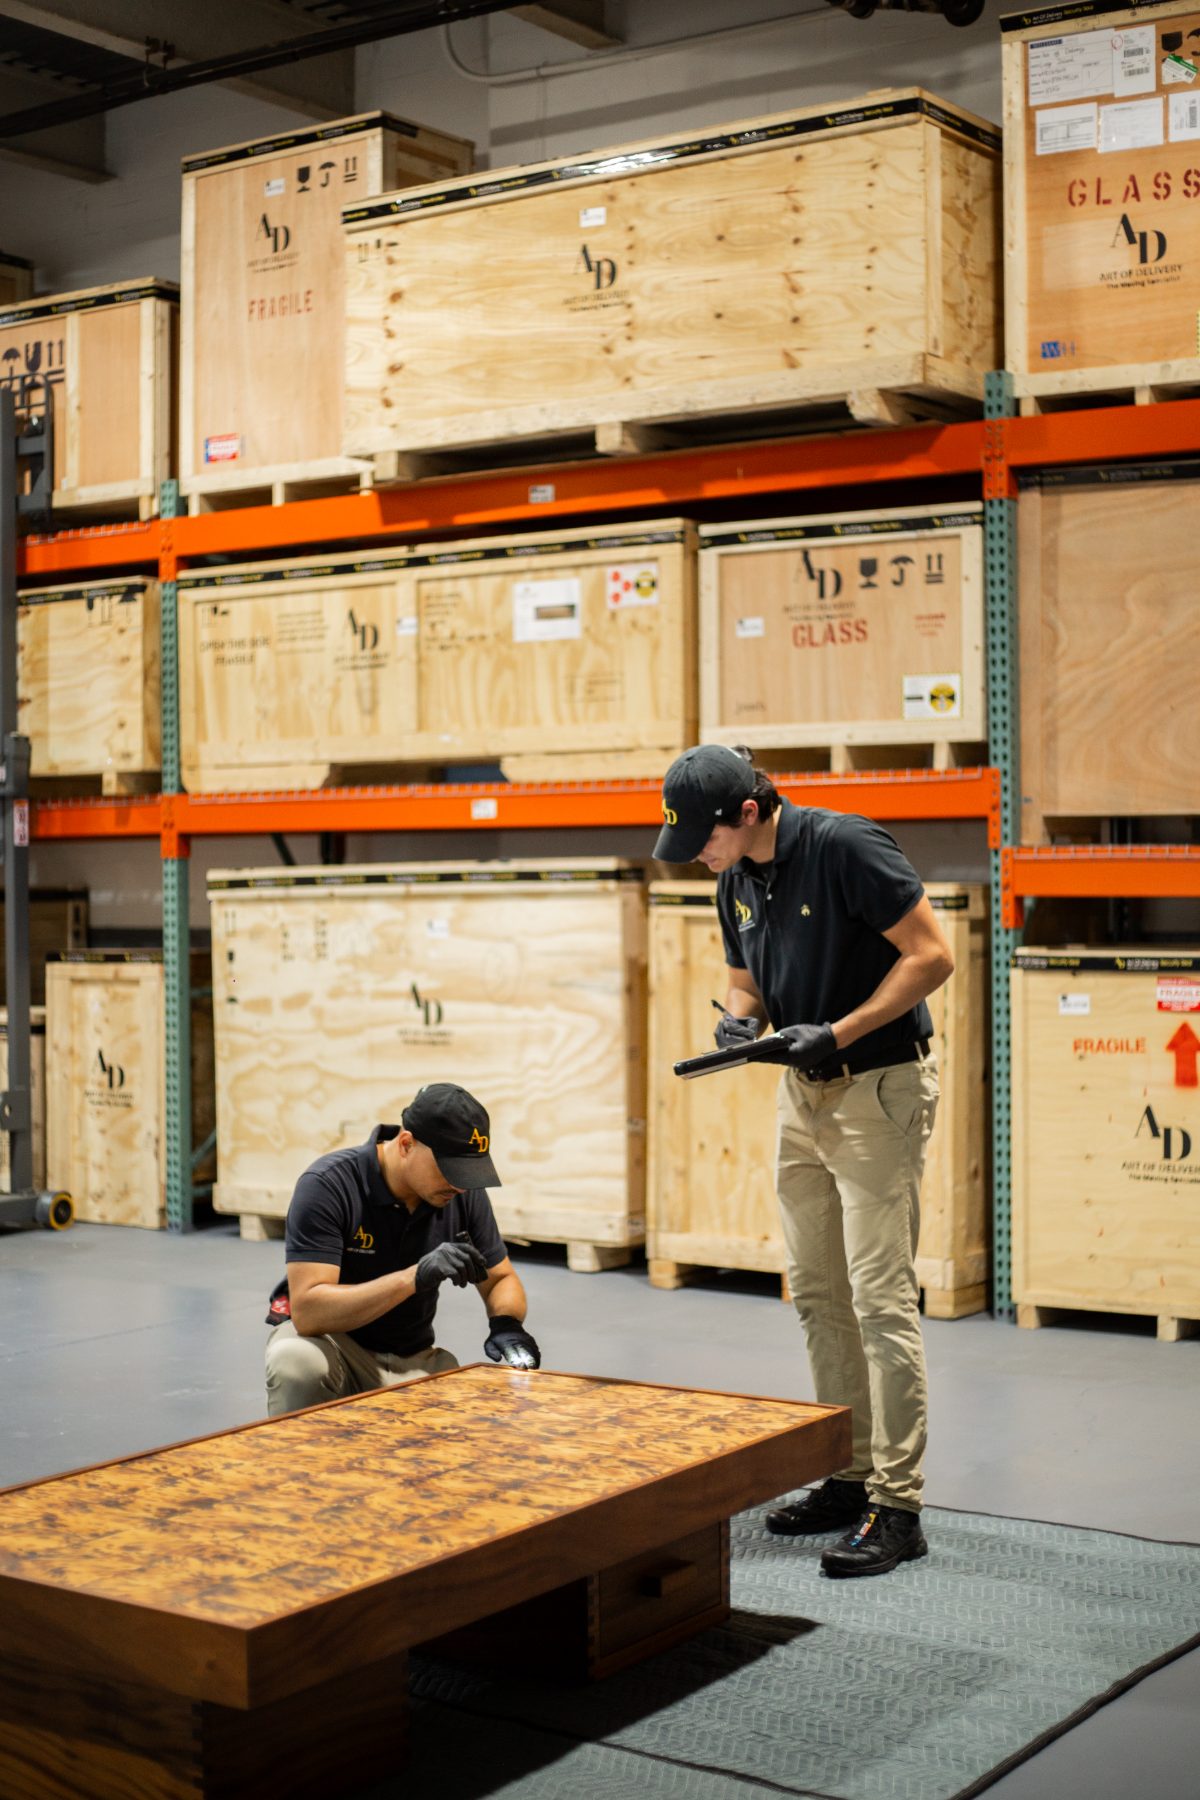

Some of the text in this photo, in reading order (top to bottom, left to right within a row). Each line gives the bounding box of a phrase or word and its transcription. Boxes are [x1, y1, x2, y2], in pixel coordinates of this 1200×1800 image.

[1067, 168, 1200, 207] GLASS
[1110, 213, 1167, 264] AD
[1100, 264, 1183, 281] ART OF DELIVERY
[248, 289, 313, 321] FRAGILE
[792, 618, 868, 648] GLASS
[1072, 1037, 1146, 1054] FRAGILE
[468, 1127, 489, 1152] AD
[1135, 1103, 1192, 1161] AD
[353, 1225, 374, 1249] AD
